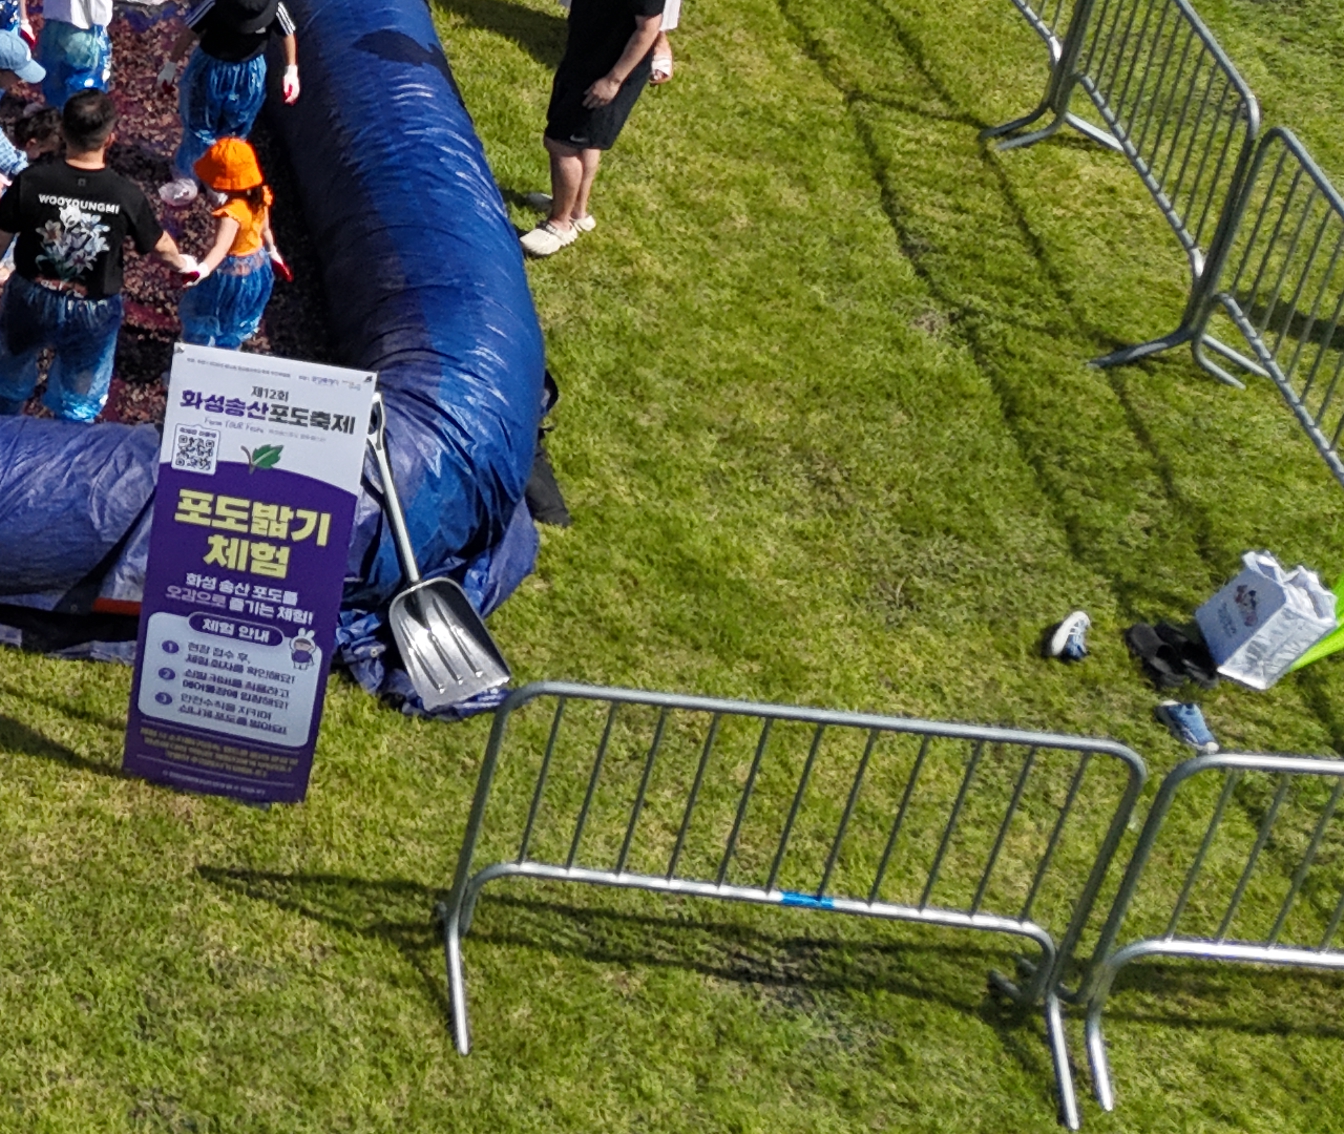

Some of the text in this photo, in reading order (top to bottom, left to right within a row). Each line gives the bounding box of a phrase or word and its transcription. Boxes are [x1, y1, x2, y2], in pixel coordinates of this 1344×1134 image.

[38, 193, 120, 215] WOOYOUNGMI
[251, 385, 289, 402] 제12회
[180, 389, 356, 435] 화성송산포도축제
[174, 488, 331, 547] 포도밟기
[203, 534, 290, 579] 체험
[165, 584, 314, 626] 오감으로 즐기는 체험!
[185, 572, 298, 606] 화성 송산 포도를
[202, 618, 270, 643] 체험 안내
[212, 647, 234, 659] 접수
